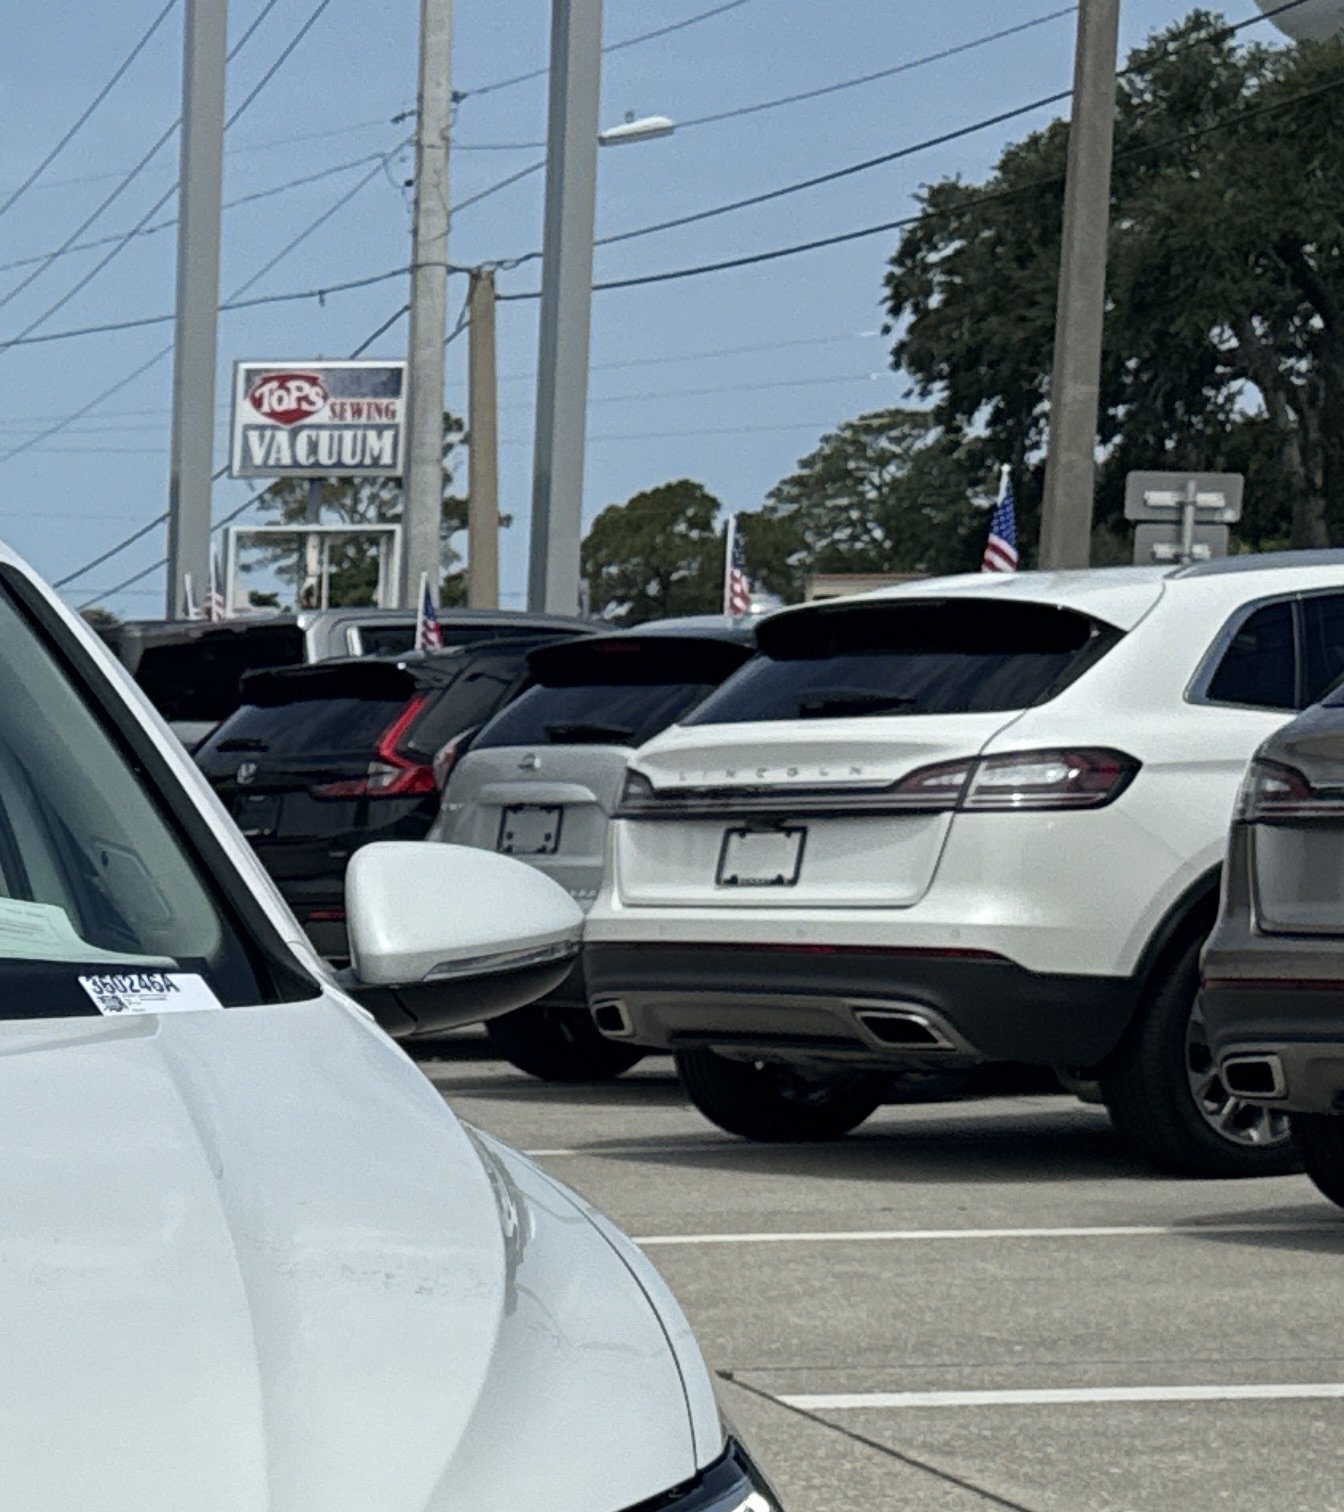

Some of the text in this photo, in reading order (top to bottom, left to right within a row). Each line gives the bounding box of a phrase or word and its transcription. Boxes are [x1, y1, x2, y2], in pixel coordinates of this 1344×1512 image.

[328, 401, 397, 422] SEWING
[246, 429, 395, 467] VACUUM
[678, 766, 862, 782] LINCOLN
